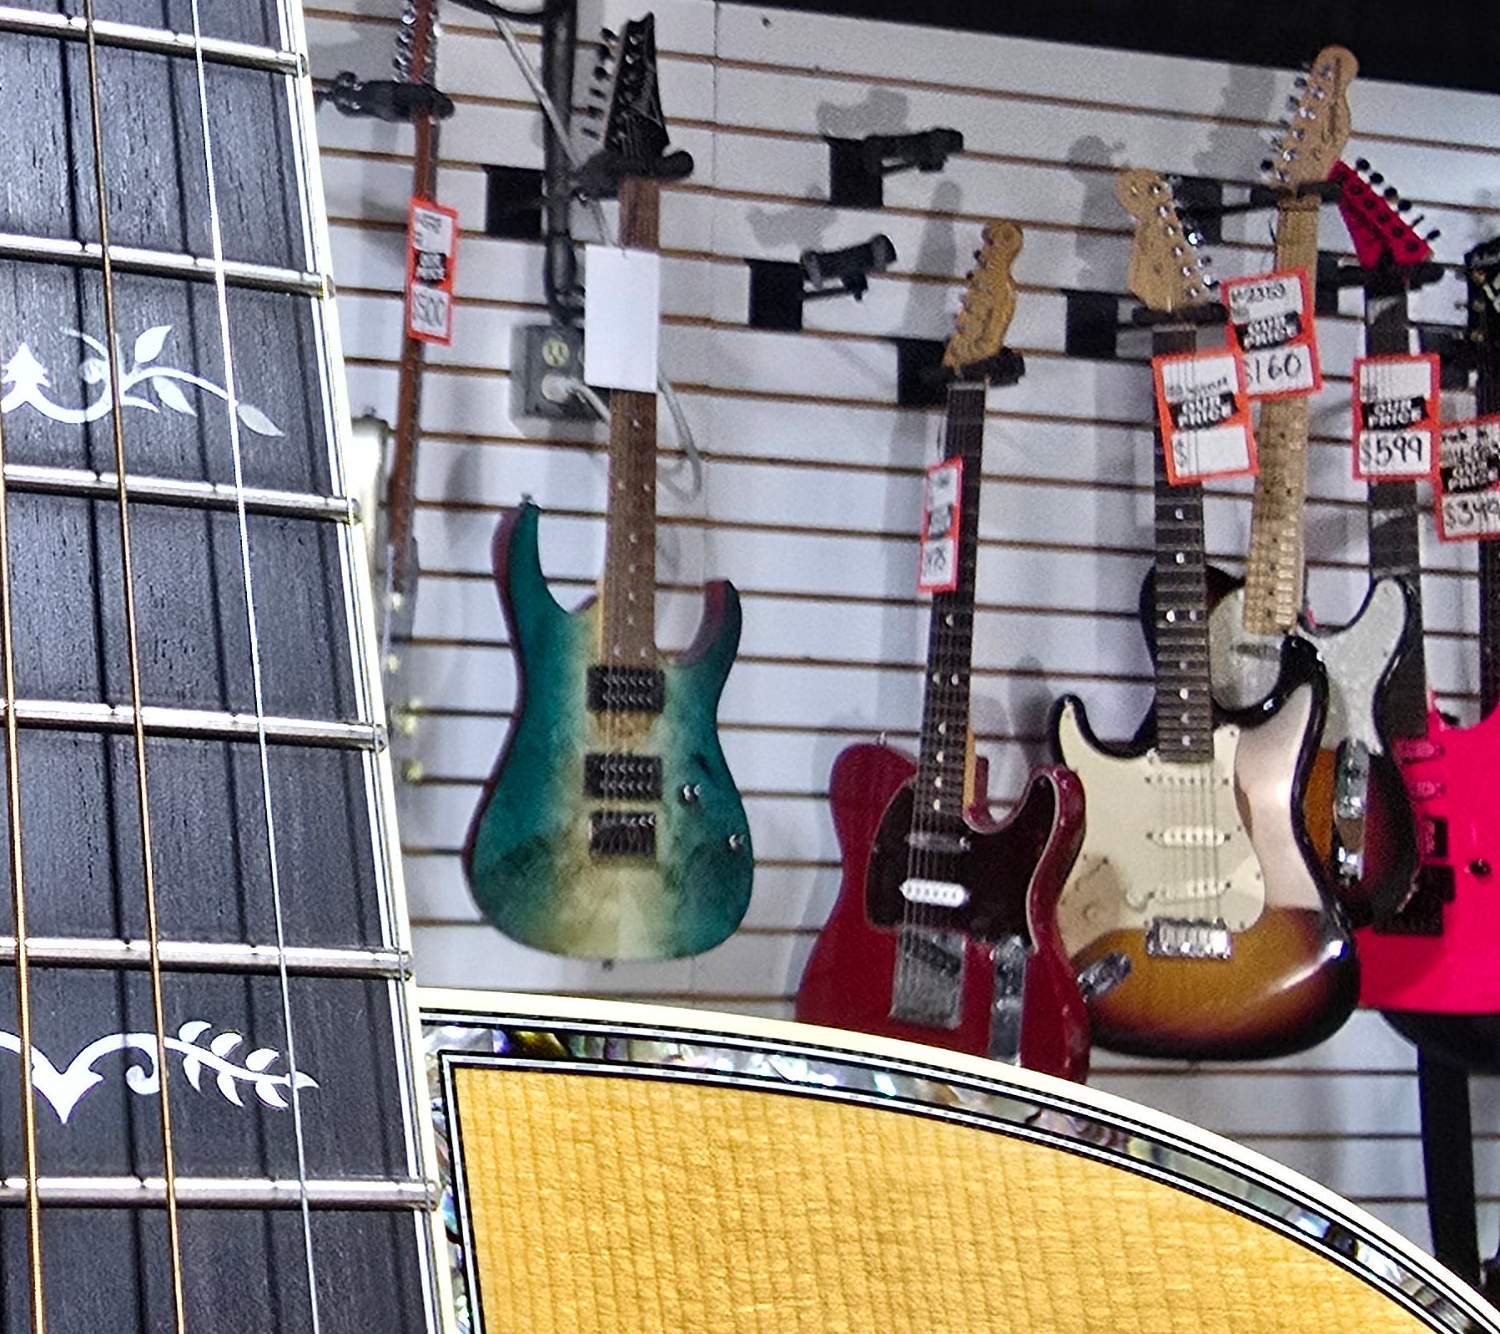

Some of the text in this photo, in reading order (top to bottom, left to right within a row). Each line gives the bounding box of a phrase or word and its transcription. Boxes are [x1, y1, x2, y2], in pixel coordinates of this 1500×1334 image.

[1368, 407, 1422, 428] PRICE
[1373, 398, 1412, 416] OUR
[1360, 435, 1423, 468] $599
